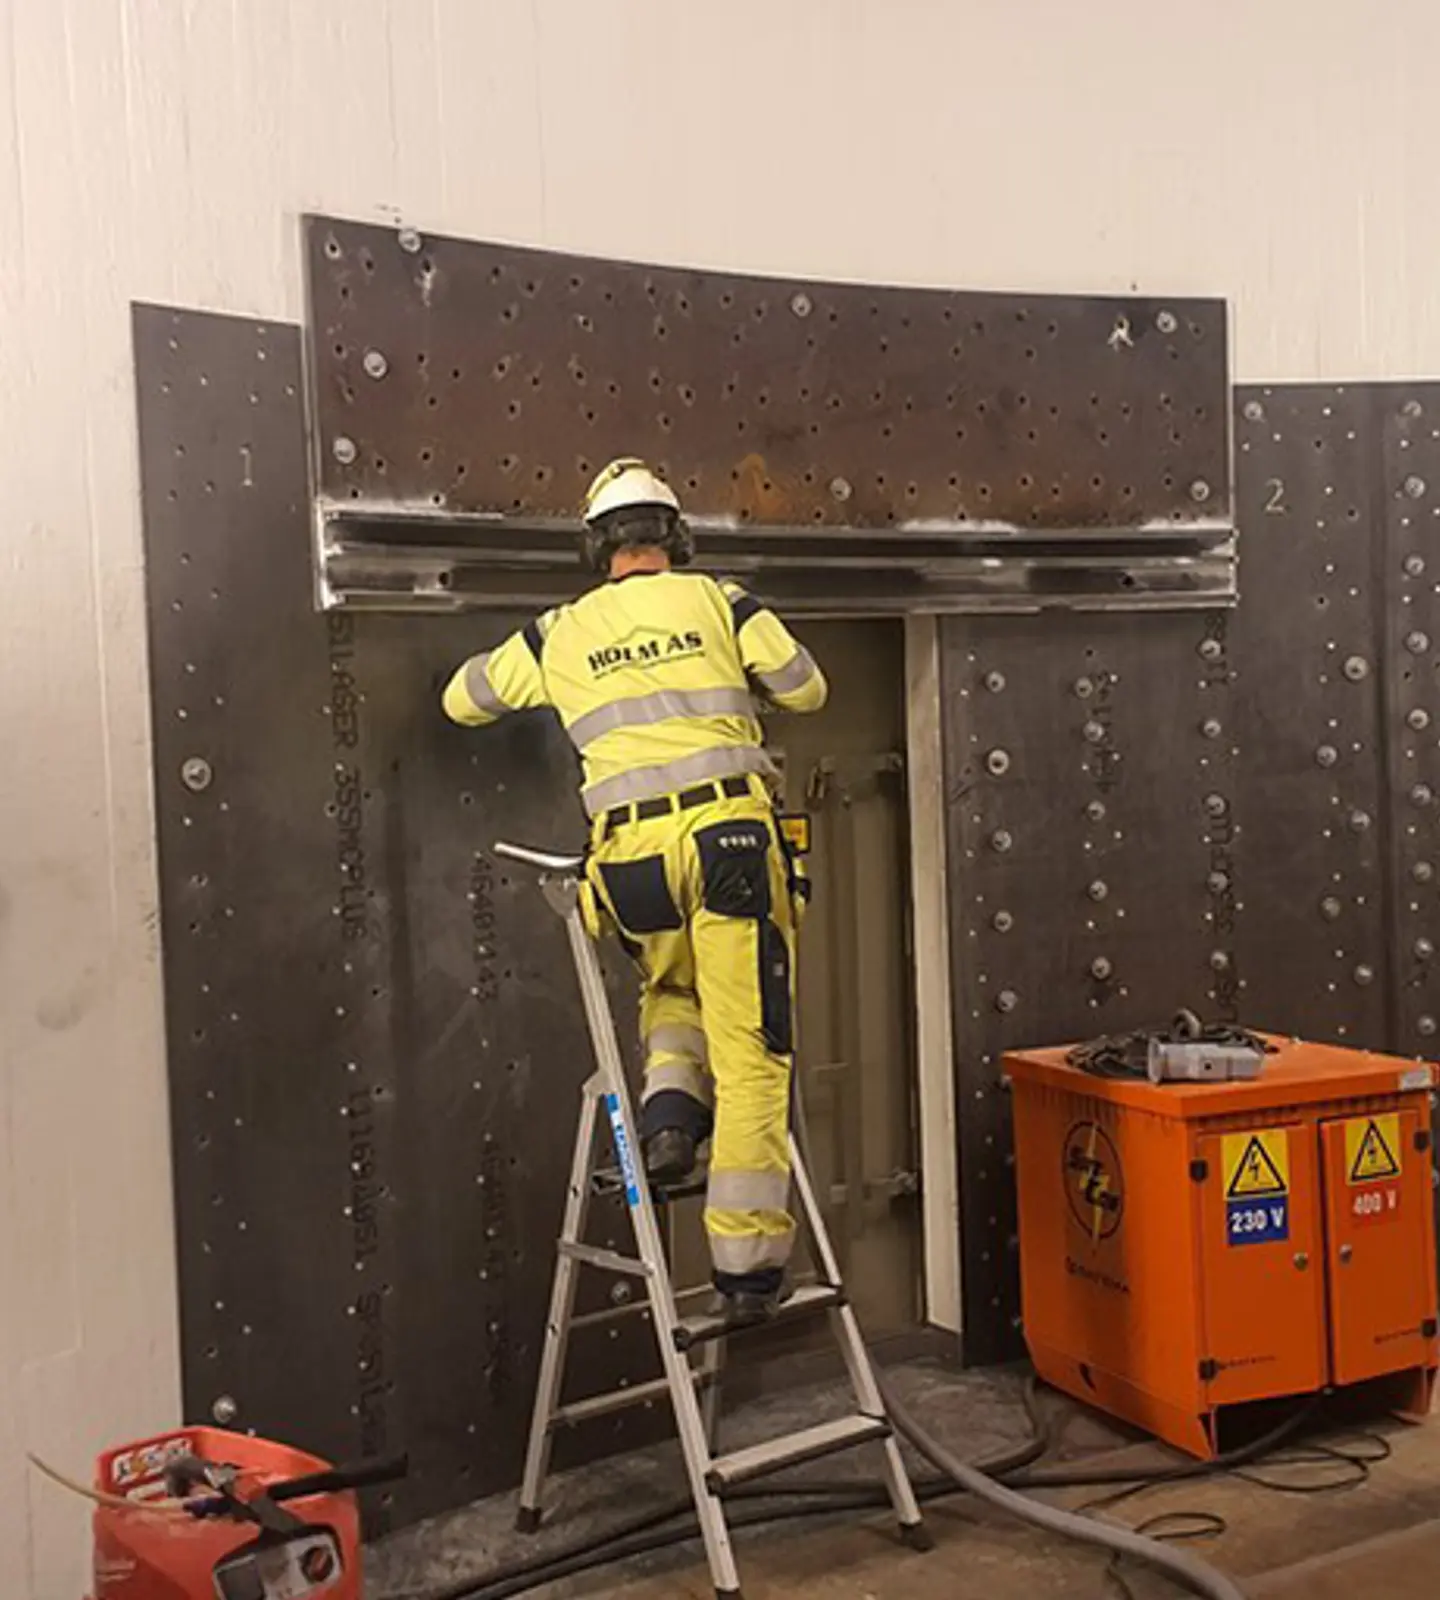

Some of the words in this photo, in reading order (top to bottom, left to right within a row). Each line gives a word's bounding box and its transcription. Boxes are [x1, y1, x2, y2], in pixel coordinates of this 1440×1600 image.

[1264, 477, 1287, 516] 2
[588, 640, 659, 672] HOLM
[666, 630, 702, 654] AS
[1353, 1192, 1381, 1214] 400
[1386, 1189, 1397, 1209] V
[1230, 1208, 1267, 1233] 230
[1270, 1206, 1284, 1228] V
